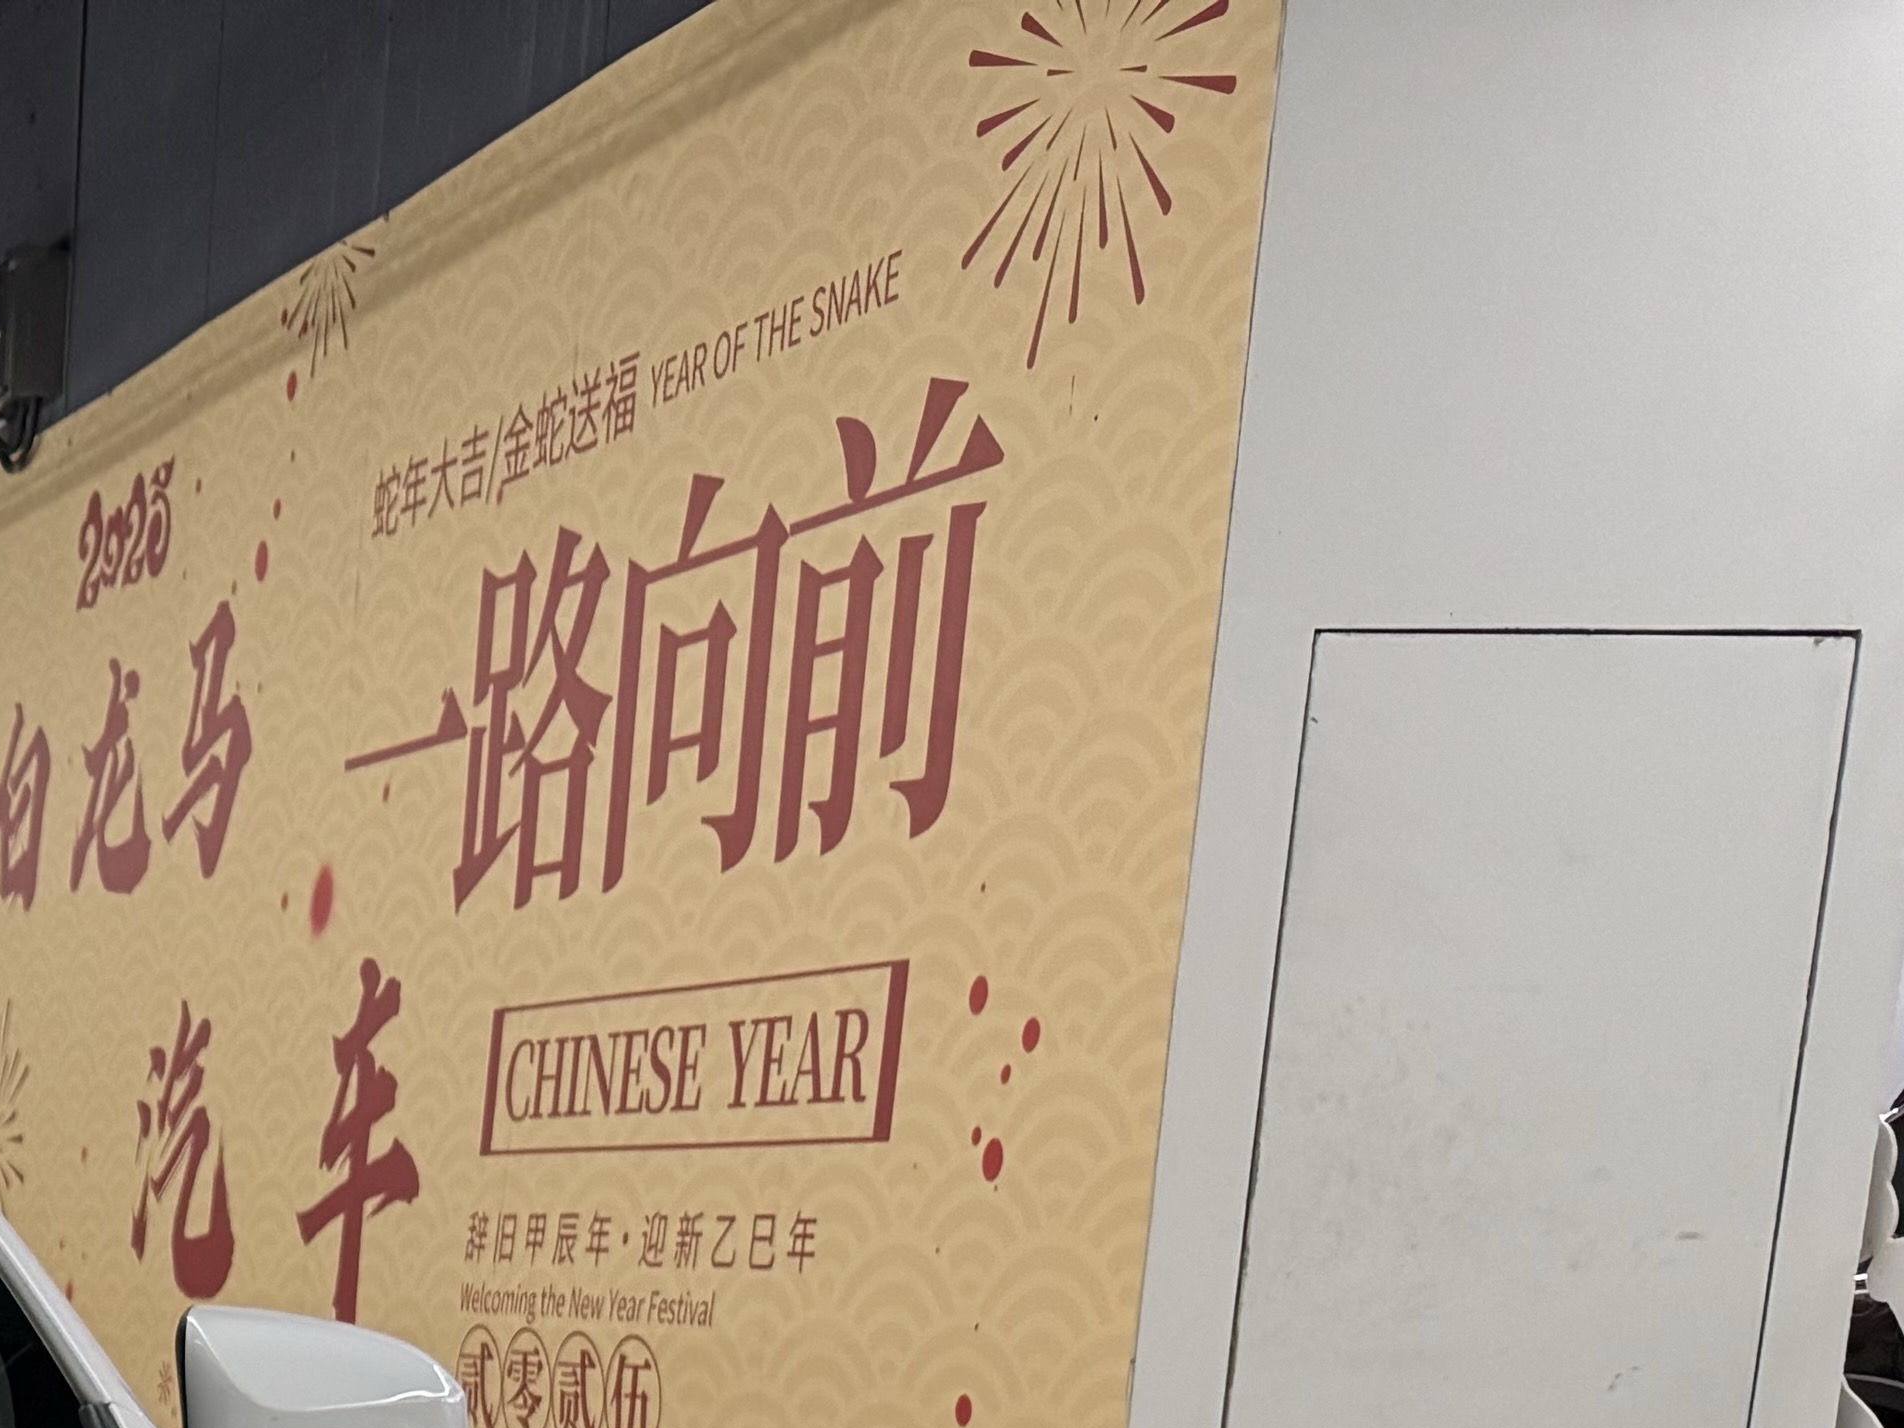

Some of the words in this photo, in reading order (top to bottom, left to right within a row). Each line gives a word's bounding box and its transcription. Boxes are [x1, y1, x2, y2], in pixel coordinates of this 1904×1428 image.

[372, 351, 640, 539] 蛇年大吉/金蛇送福
[651, 342, 708, 408] YEAR
[713, 321, 748, 380] OF
[754, 295, 805, 363] THE
[809, 249, 903, 338] SNAKE
[76, 453, 176, 613] 2025
[344, 376, 1005, 916] 一路向前
[131, 957, 420, 1323] 汽车
[505, 1023, 707, 1123] CHINESE
[727, 1007, 870, 1110] YEAR
[459, 1281, 537, 1325] Welcoming
[541, 1283, 565, 1318] the
[568, 1286, 603, 1320] New
[607, 1287, 643, 1322] Year
[647, 1289, 717, 1328] Festival
